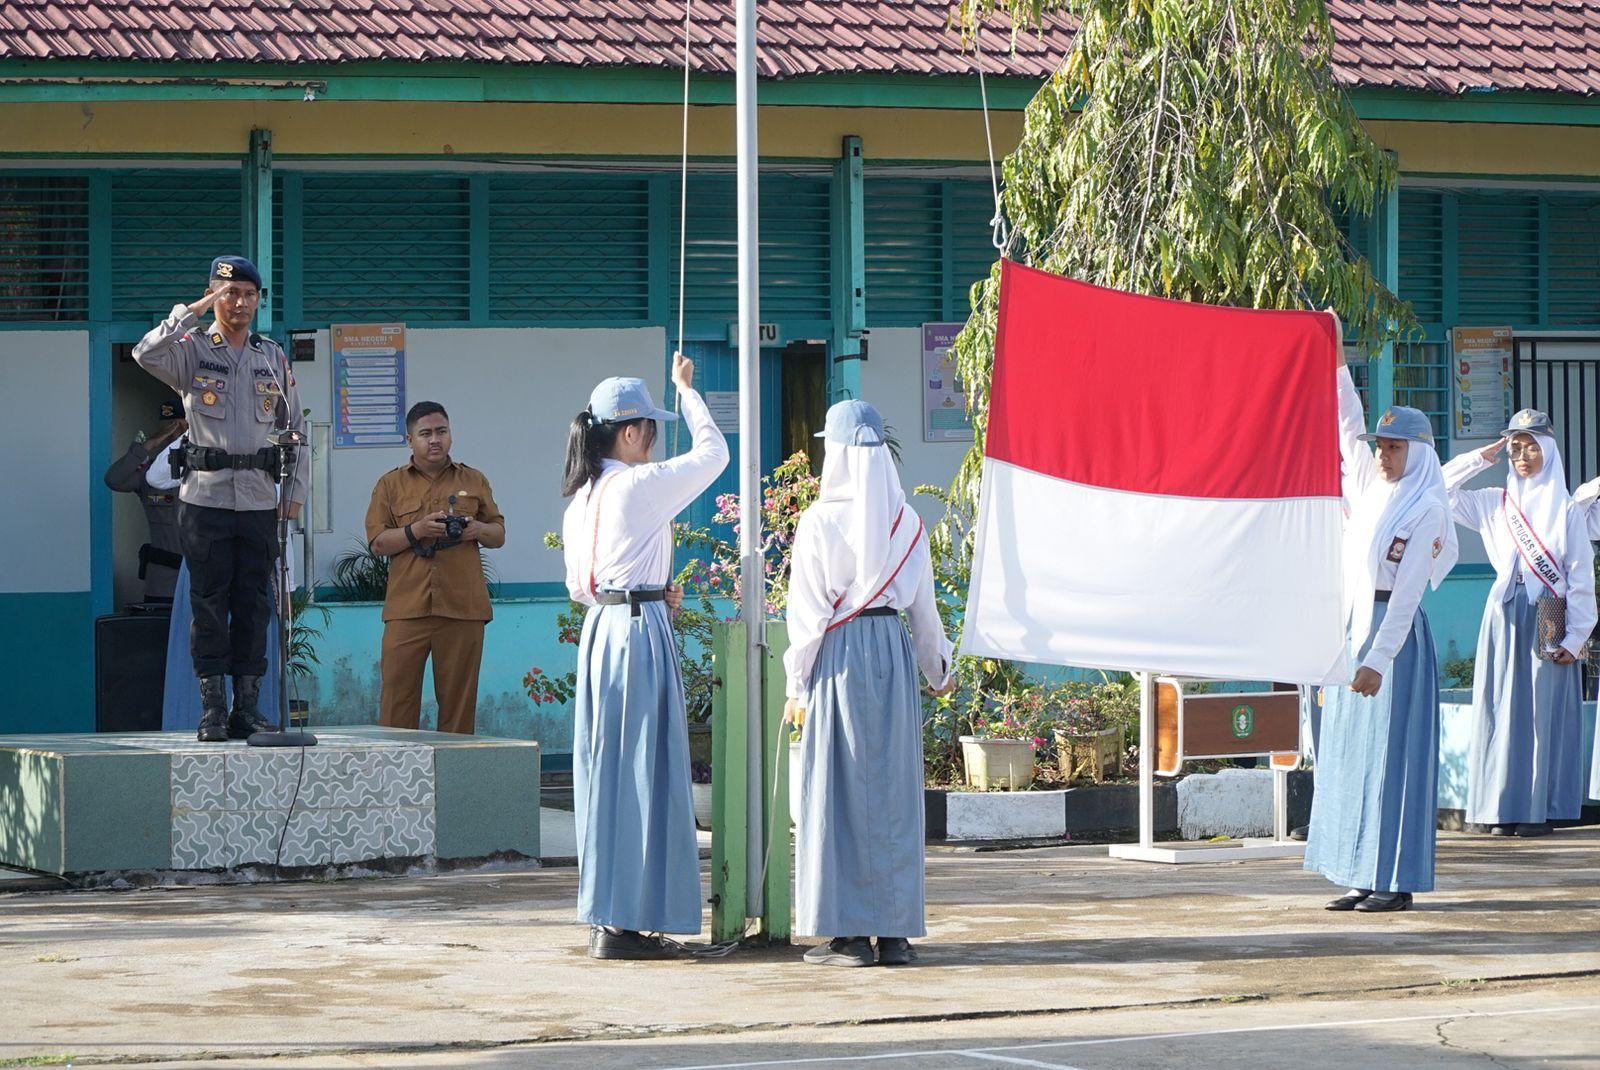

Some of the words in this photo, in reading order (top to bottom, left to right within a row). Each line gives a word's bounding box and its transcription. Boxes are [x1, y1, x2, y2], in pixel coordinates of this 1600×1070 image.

[199, 361, 229, 375] DADANG
[1511, 515, 1535, 551] PETUGAS
[1530, 550, 1560, 585] UPACARA
